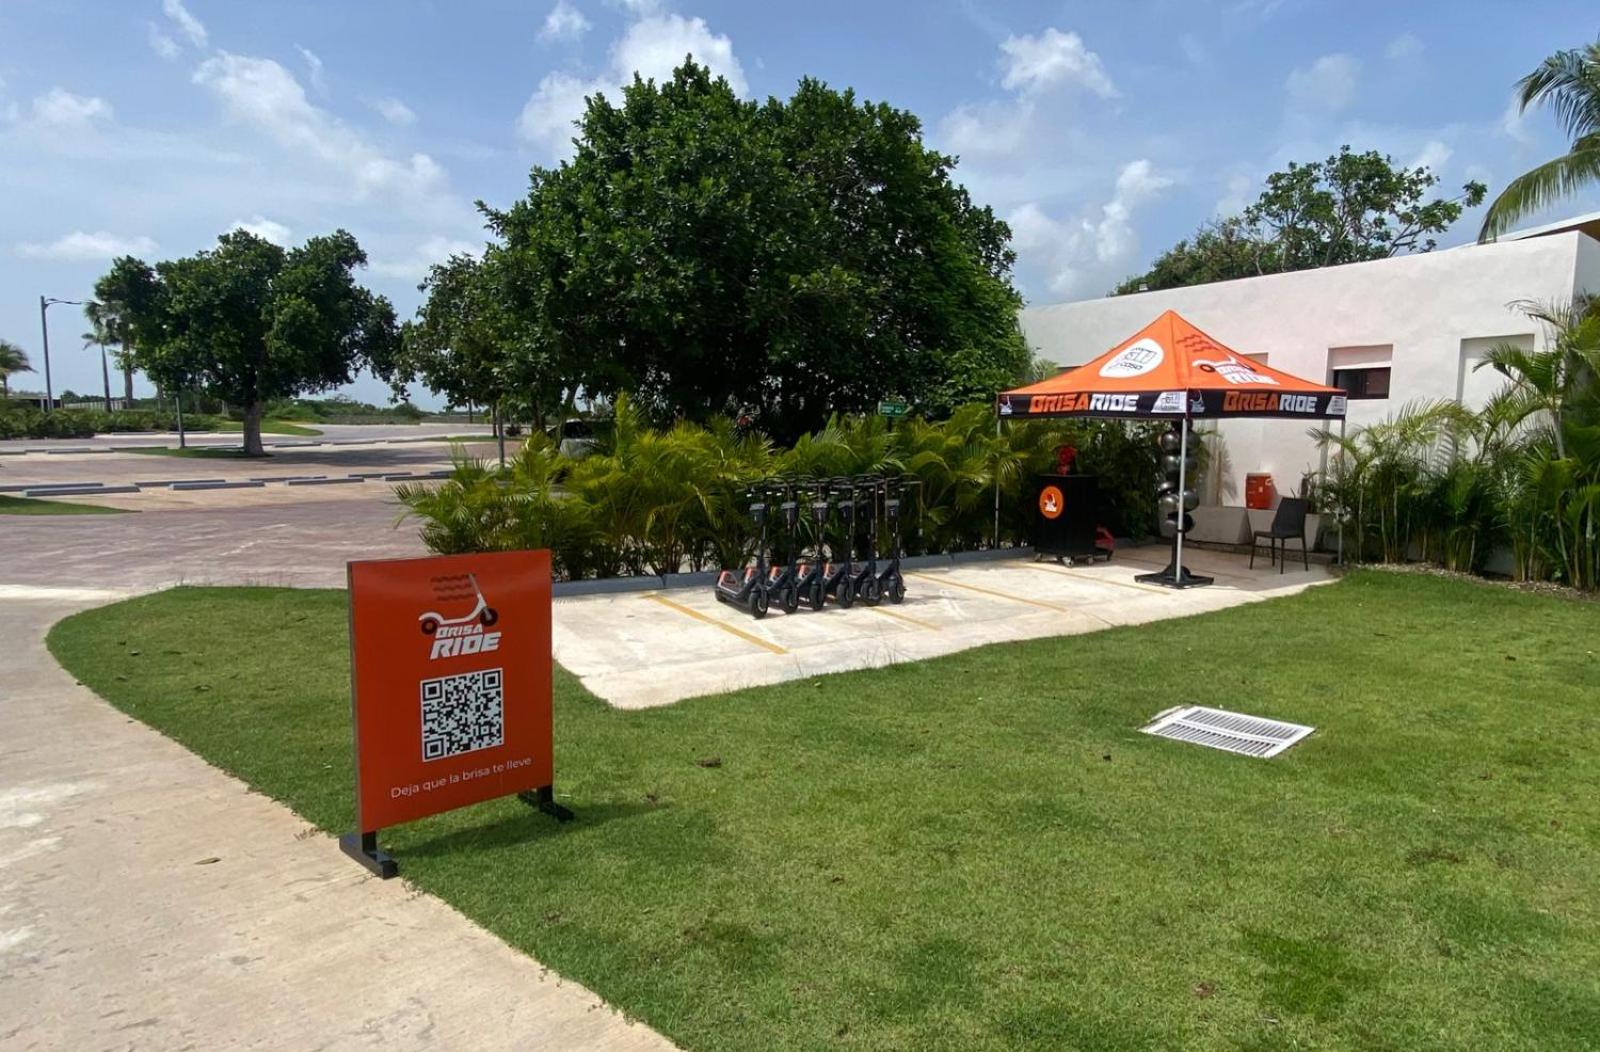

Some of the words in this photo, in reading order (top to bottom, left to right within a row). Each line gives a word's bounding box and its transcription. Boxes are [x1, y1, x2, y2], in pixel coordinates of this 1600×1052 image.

[430, 631, 502, 660] RIDE
[435, 623, 483, 639] BRISA
[390, 784, 420, 798] Deja
[422, 777, 447, 792] que
[449, 774, 460, 784] la
[462, 767, 491, 781] brisa
[492, 763, 505, 773] te
[506, 757, 532, 770] lleve
